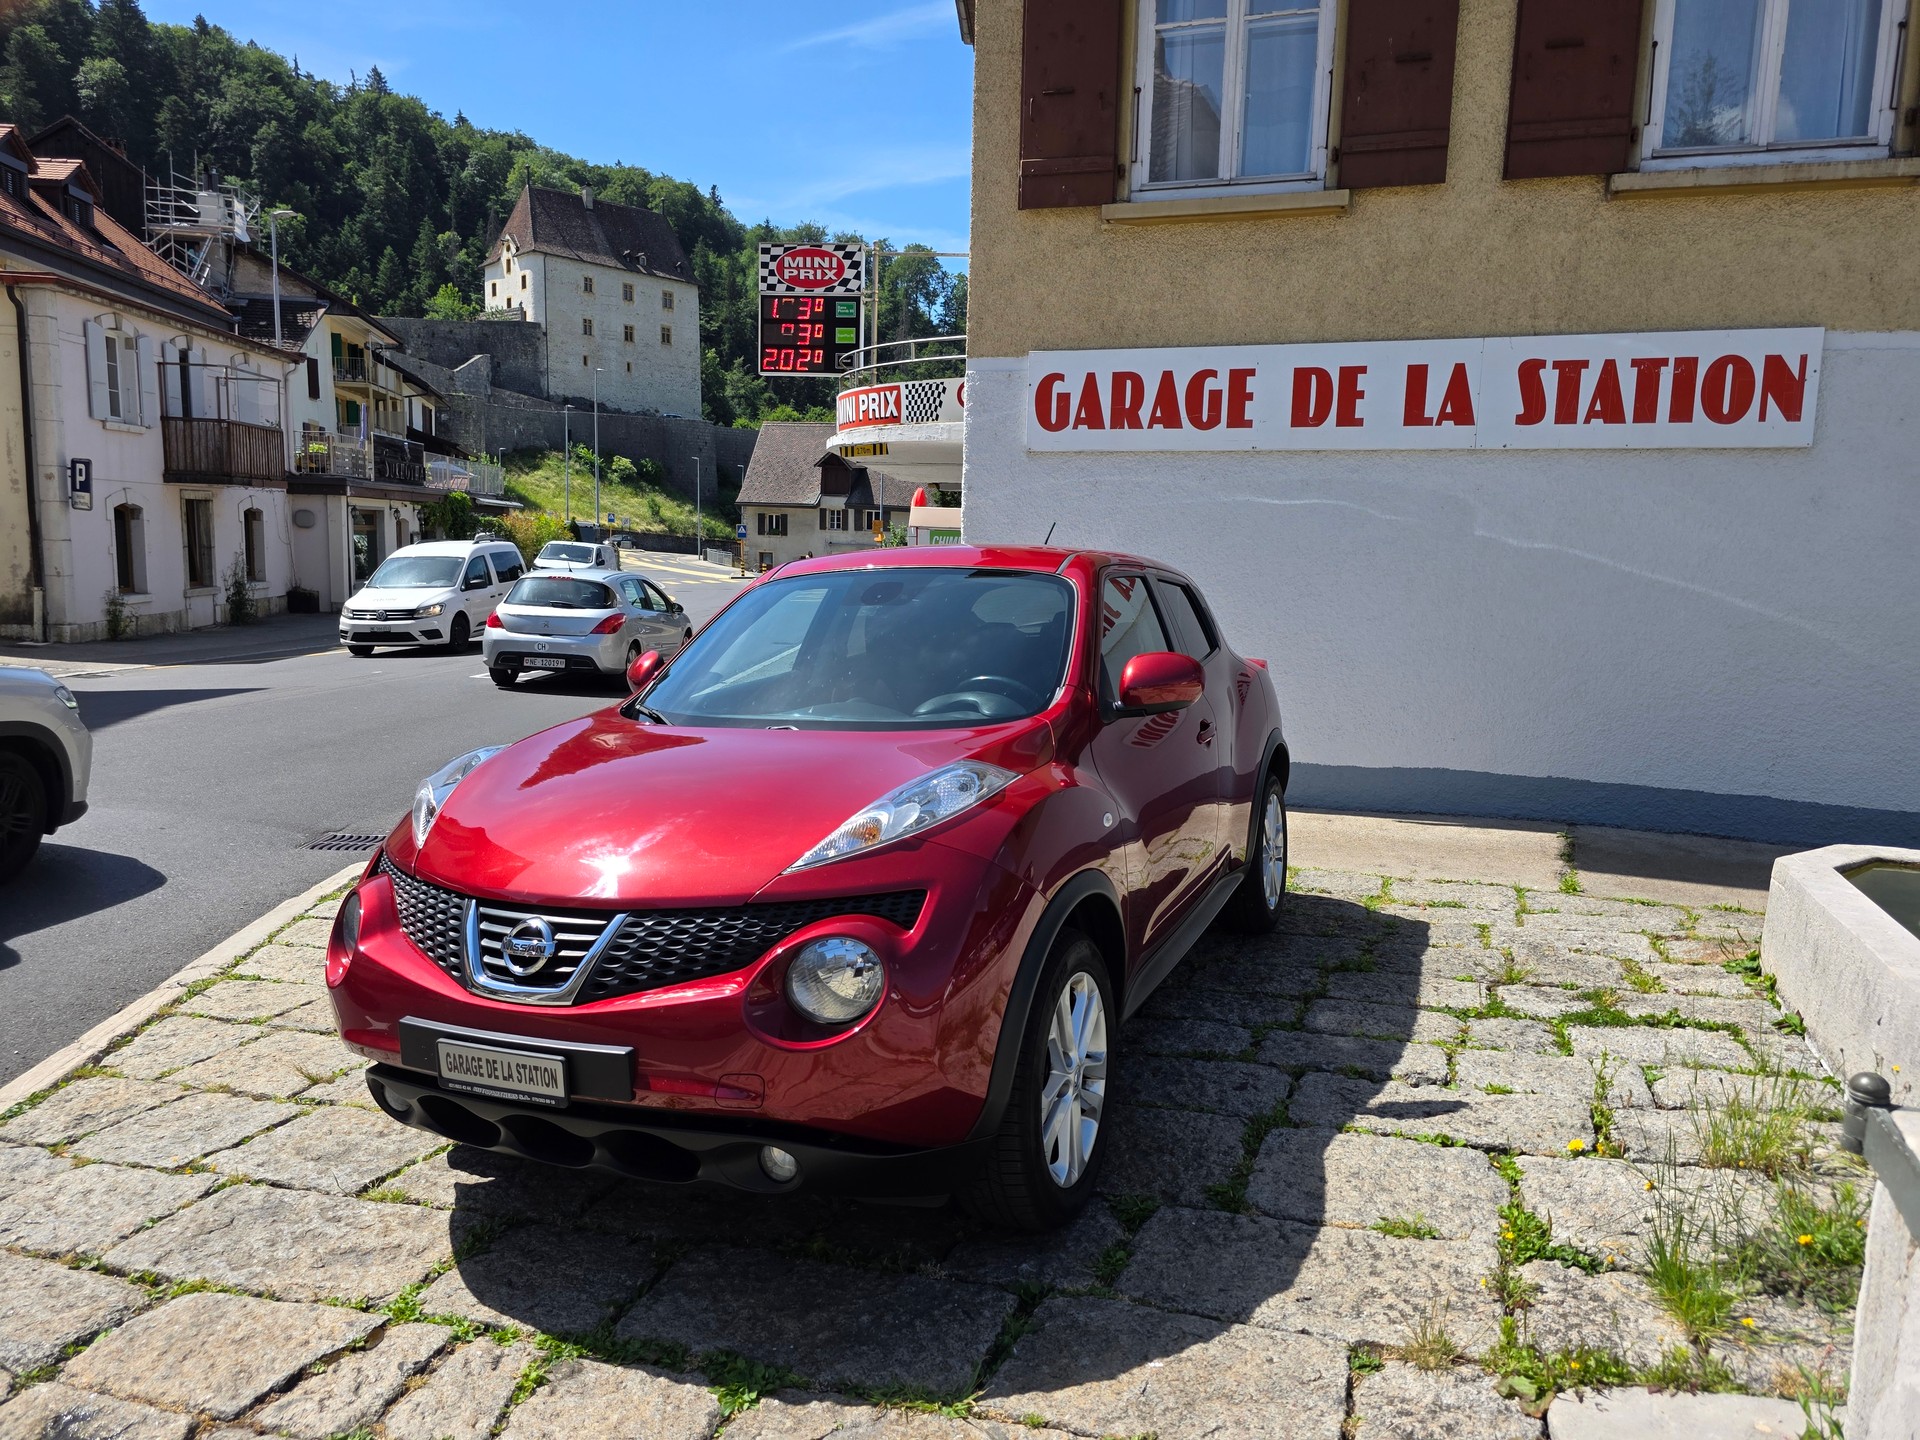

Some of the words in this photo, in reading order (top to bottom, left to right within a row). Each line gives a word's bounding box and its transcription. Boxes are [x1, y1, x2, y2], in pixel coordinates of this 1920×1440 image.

[784, 256, 838, 268] MINI
[784, 269, 838, 280] PRIX
[859, 390, 899, 421] PRIX
[1034, 368, 1257, 433] GARAGE
[1290, 365, 1368, 428] DE
[1403, 362, 1476, 427] LA
[1515, 353, 1808, 426] STATION
[76, 463, 86, 490] P
[537, 642, 546, 651] CH
[445, 1051, 484, 1078] GARAGE
[485, 1058, 500, 1081] DE
[500, 1060, 515, 1083] LA
[516, 1062, 559, 1090] STATION
